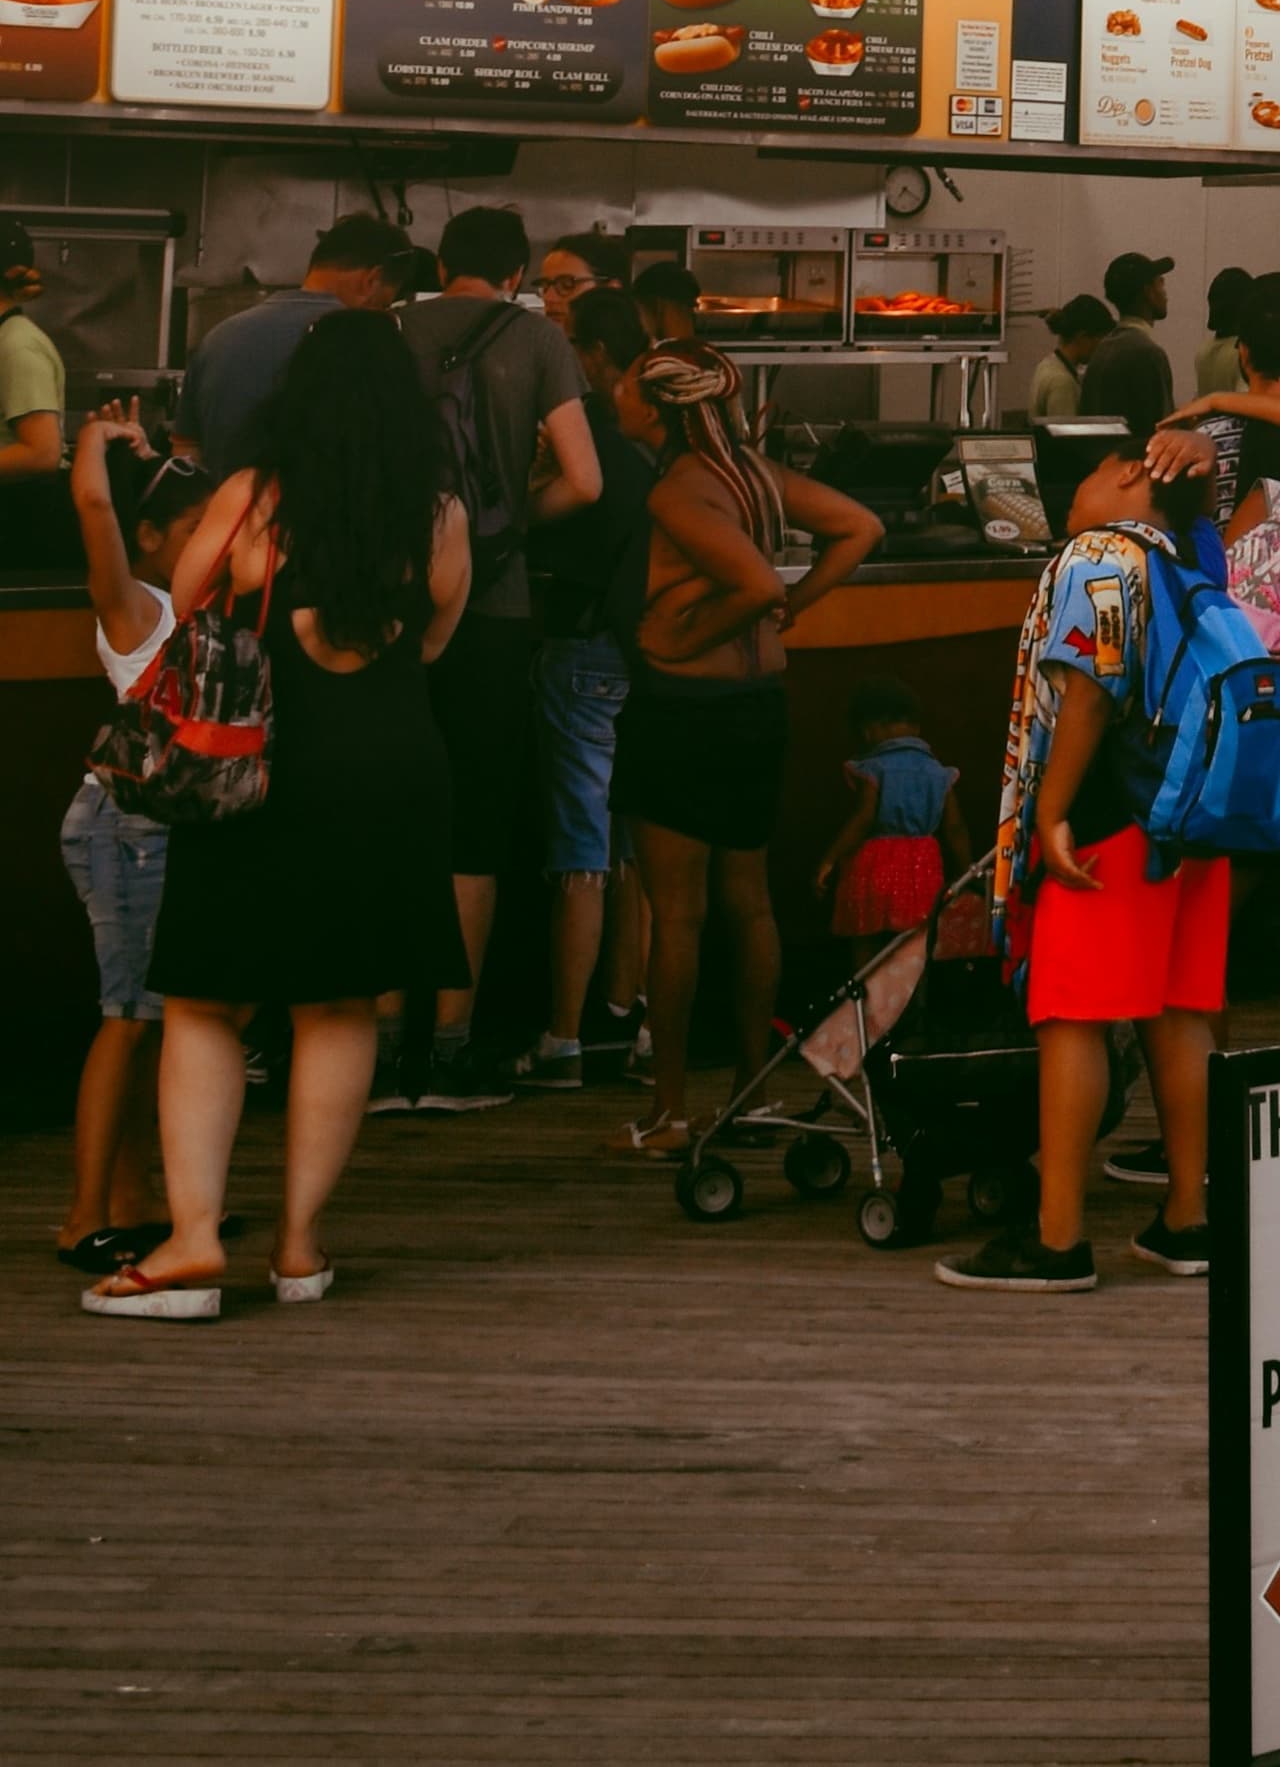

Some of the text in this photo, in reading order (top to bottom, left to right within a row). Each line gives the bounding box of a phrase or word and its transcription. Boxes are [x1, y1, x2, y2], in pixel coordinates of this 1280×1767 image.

[513, 3, 592, 15] FISH SANDWICH
[749, 31, 774, 40] CHILI
[419, 36, 488, 48] CLAM ORDER
[508, 40, 595, 52] POPCORN SHRIMP
[748, 42, 804, 52] CHEESE DOG
[152, 43, 222, 55] BOTTLED BEER
[388, 64, 464, 76] LOBSTER ROLL
[1198, 58, 1212, 70] Dog
[474, 68, 542, 79] SHRIMP ROLL
[552, 71, 610, 81] CLAM ROLL
[955, 120, 974, 130] VISA
